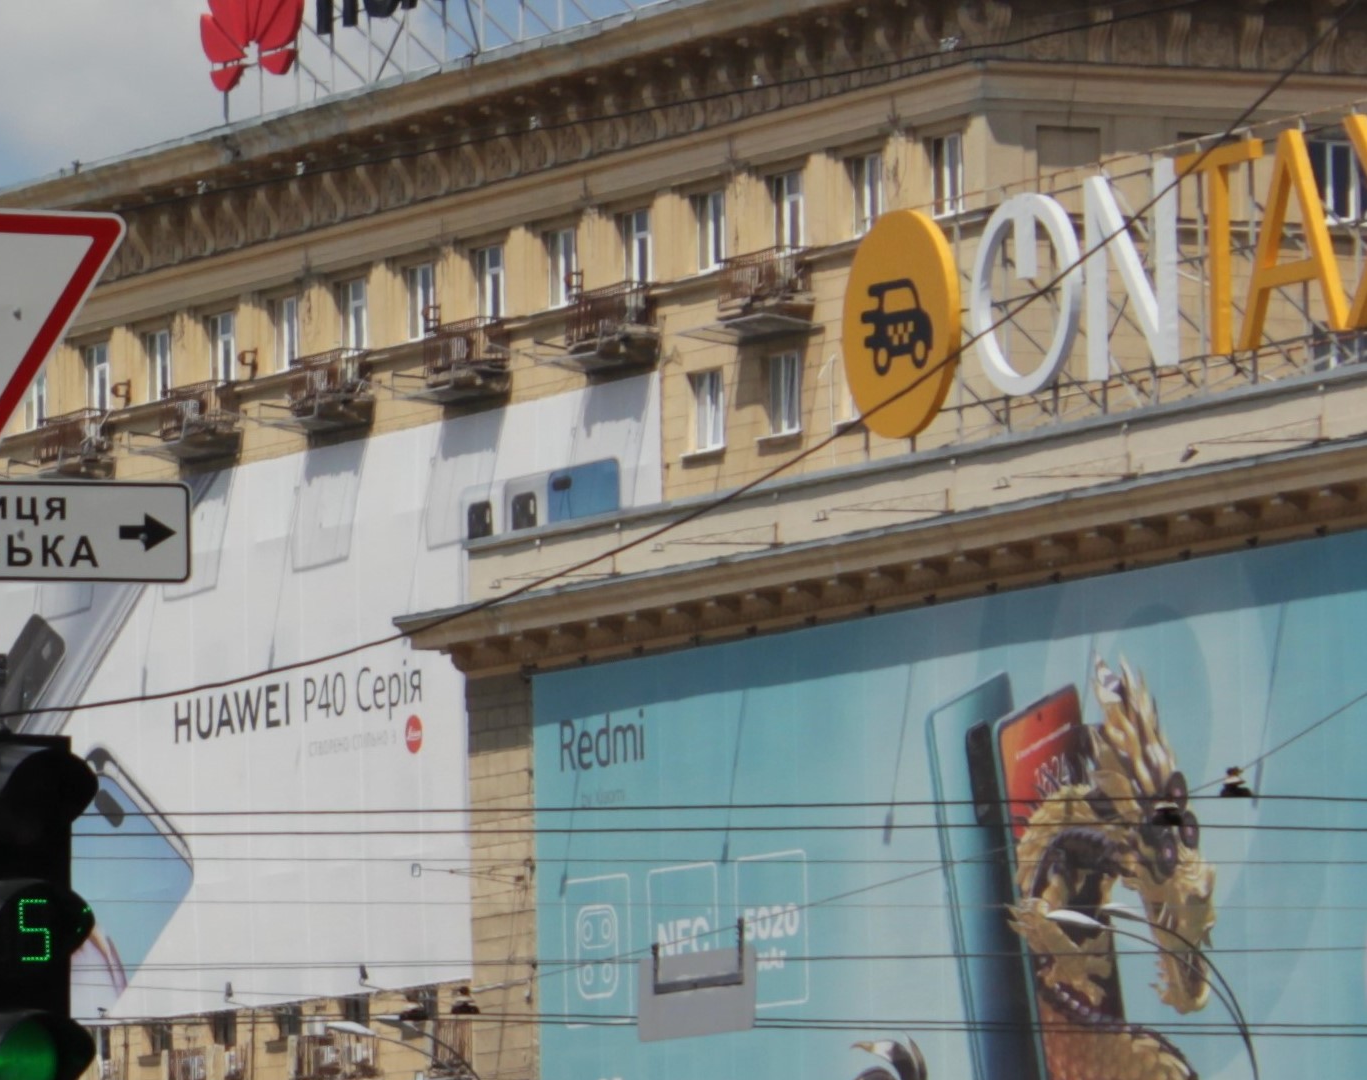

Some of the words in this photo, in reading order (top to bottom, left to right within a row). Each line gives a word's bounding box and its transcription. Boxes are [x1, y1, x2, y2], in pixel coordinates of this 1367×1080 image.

[971, 114, 1367, 396] ONTA
[173, 681, 291, 744] HUAWEI
[303, 671, 347, 722] P40
[356, 659, 423, 721] Серія
[559, 708, 645, 773] Redmi
[18, 898, 51, 962] 5
[657, 916, 710, 958] NFC
[742, 902, 801, 942] 5020
